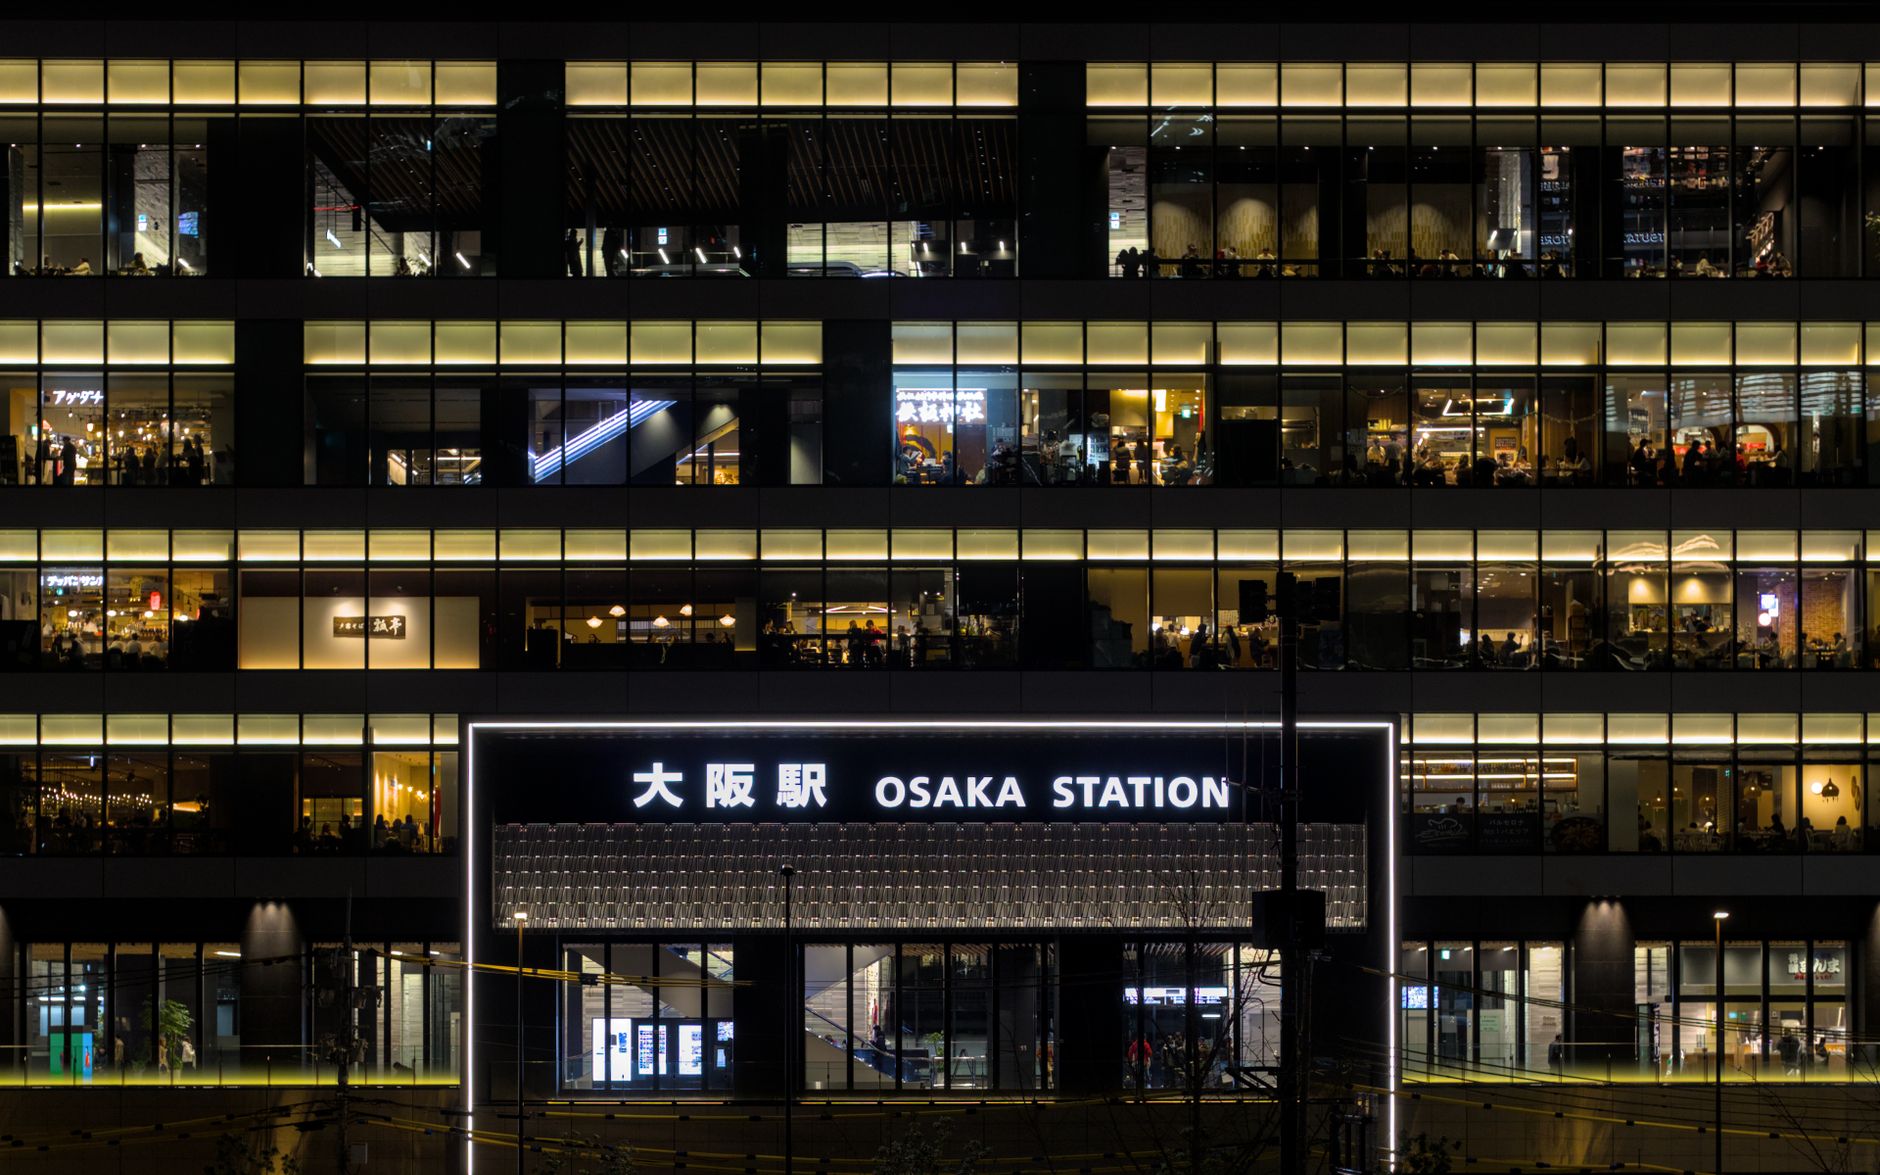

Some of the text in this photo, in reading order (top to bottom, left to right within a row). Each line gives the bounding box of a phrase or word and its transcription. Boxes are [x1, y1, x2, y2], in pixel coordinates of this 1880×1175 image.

[633, 762, 1230, 808] 大阪駅 OSAKA STATION
